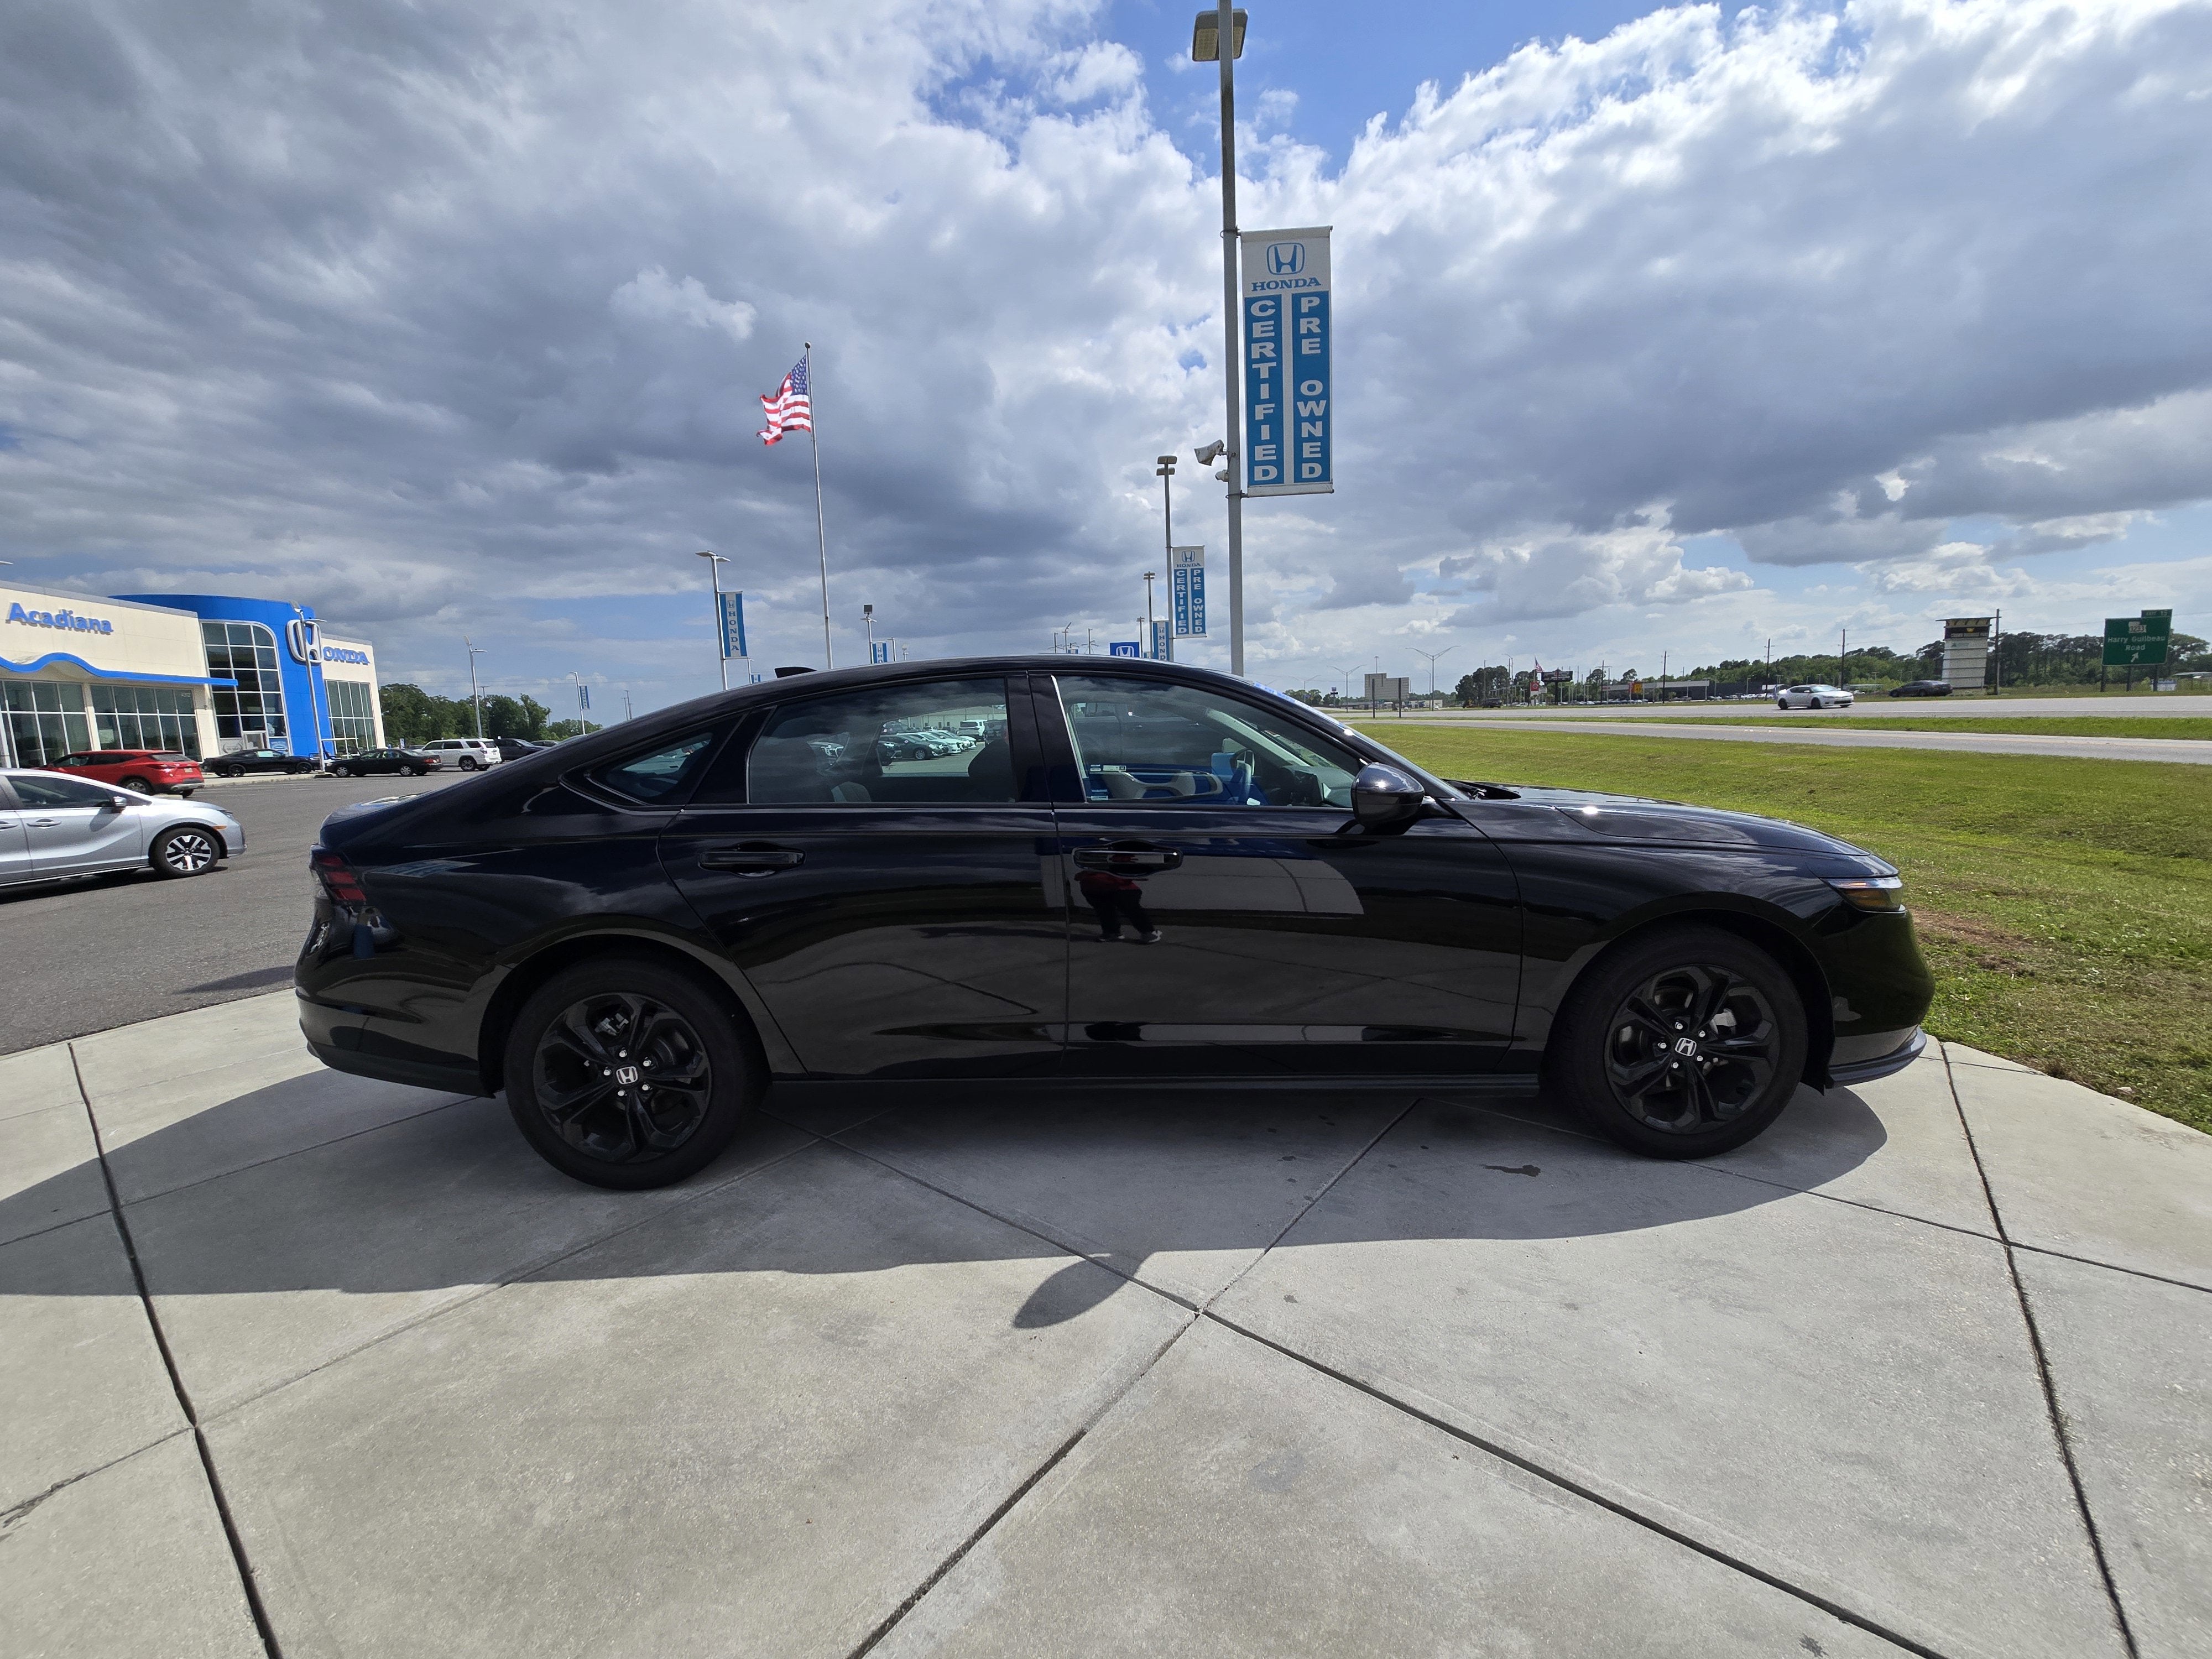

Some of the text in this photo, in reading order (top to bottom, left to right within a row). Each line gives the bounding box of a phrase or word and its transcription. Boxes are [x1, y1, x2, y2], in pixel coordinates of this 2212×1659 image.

[1251, 276, 1321, 291] HONDA
[1250, 300, 1278, 481] CERTIFIED
[1297, 296, 1326, 479] PRE OWNED
[8, 602, 114, 634] Acadiana
[1176, 570, 1187, 634] CERTIFIED
[1193, 598, 1204, 633] OWNED
[728, 611, 739, 651] HONDA
[323, 646, 371, 665] ONDA
